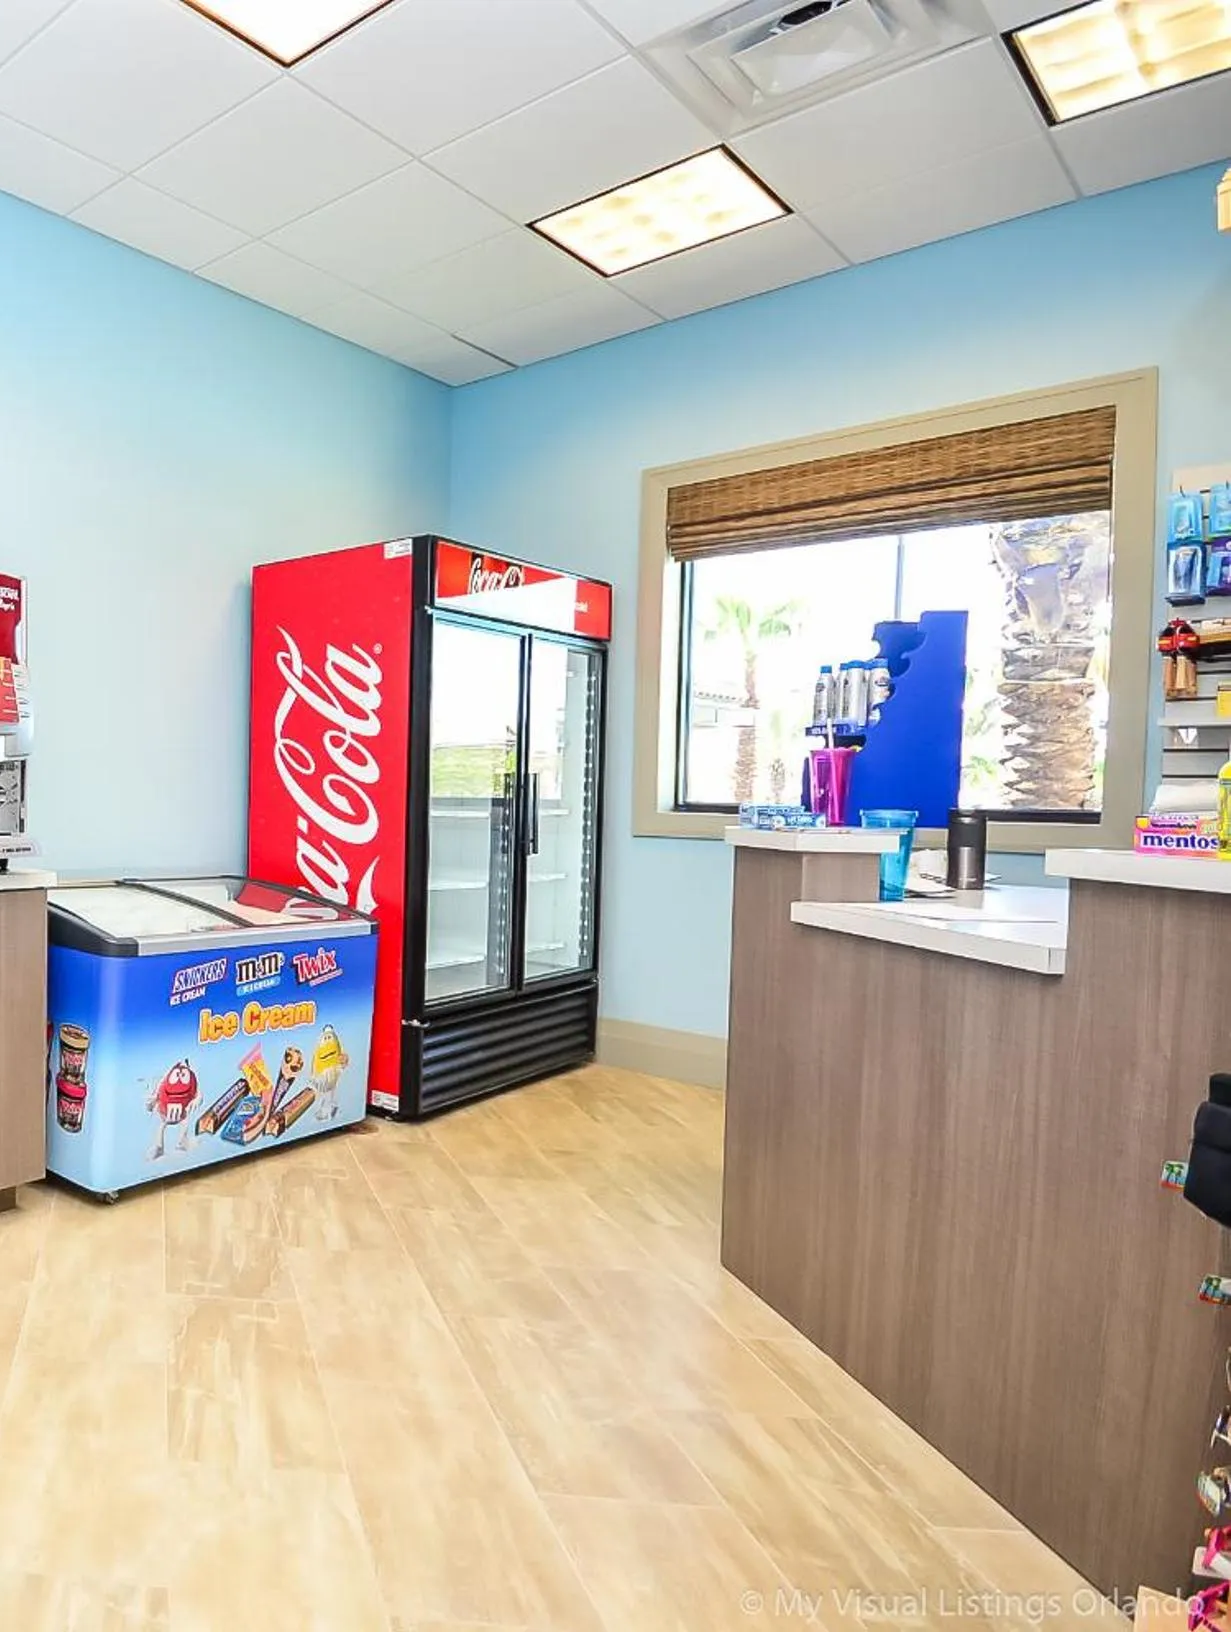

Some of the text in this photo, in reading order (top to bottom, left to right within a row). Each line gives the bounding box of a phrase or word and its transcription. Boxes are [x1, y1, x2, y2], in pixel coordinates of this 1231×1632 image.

[1143, 834, 1220, 849] mentos
[198, 1001, 316, 1044] Ice Cream
